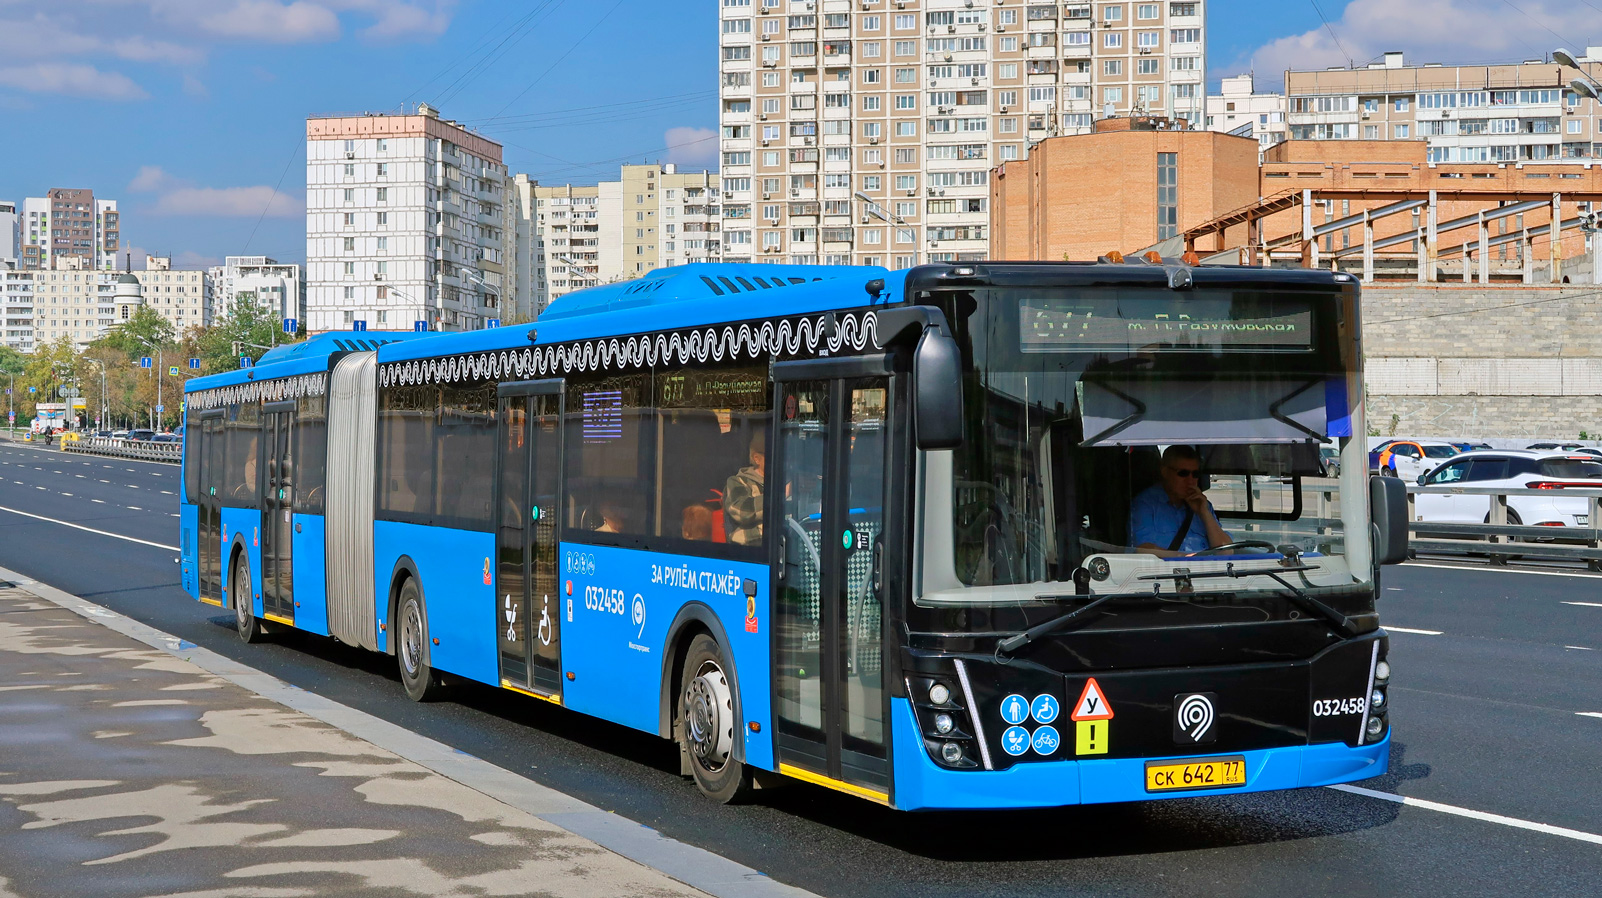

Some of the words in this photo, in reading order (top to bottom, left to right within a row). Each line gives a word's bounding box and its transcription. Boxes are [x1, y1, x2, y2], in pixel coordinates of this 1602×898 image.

[651, 564, 663, 584] ЗА
[664, 563, 698, 590] РУЛЁМ
[699, 569, 741, 596] СТАЖЁР
[585, 585, 625, 616] 032458
[1313, 696, 1365, 717] 032458
[1183, 764, 1214, 784] 642
[1224, 761, 1239, 777] 77
